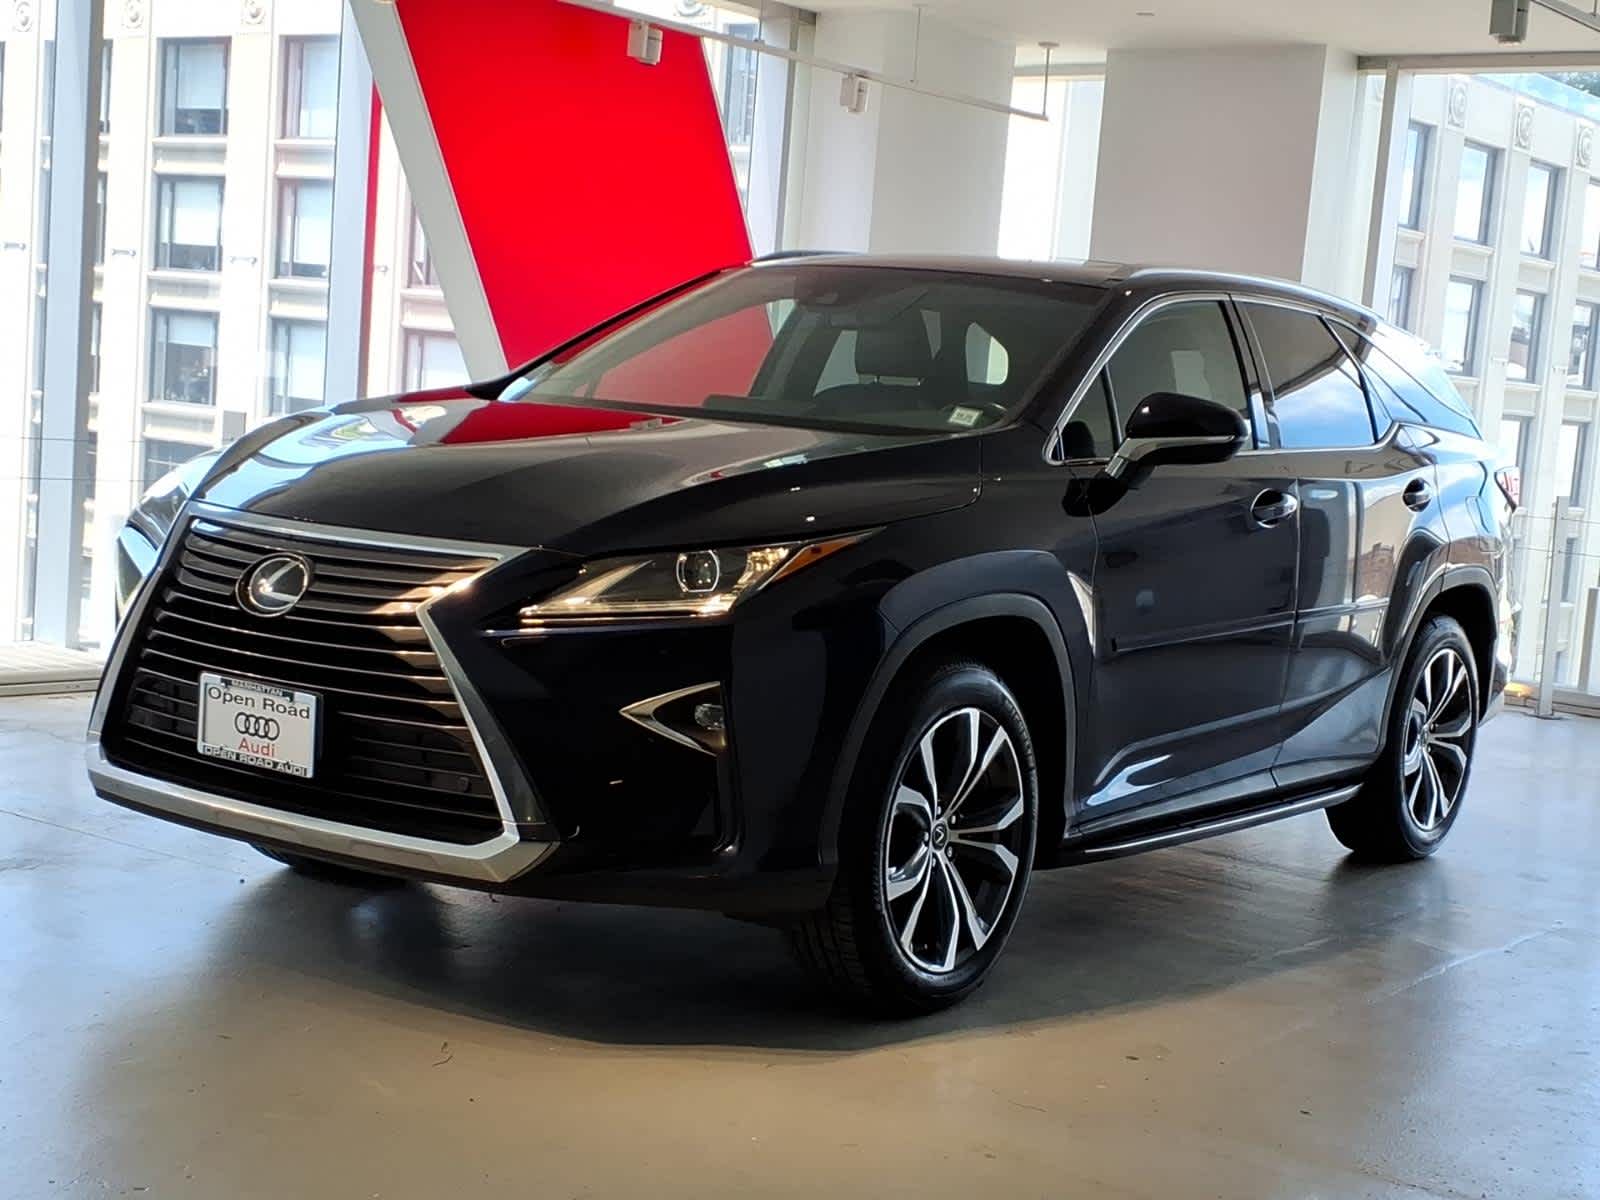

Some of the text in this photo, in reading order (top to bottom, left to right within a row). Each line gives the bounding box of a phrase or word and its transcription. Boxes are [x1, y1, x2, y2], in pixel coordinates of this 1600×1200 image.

[208, 687, 310, 719] Open Road
[205, 746, 306, 777] OPEN ROAD AUDI
[238, 738, 276, 757] Audi
